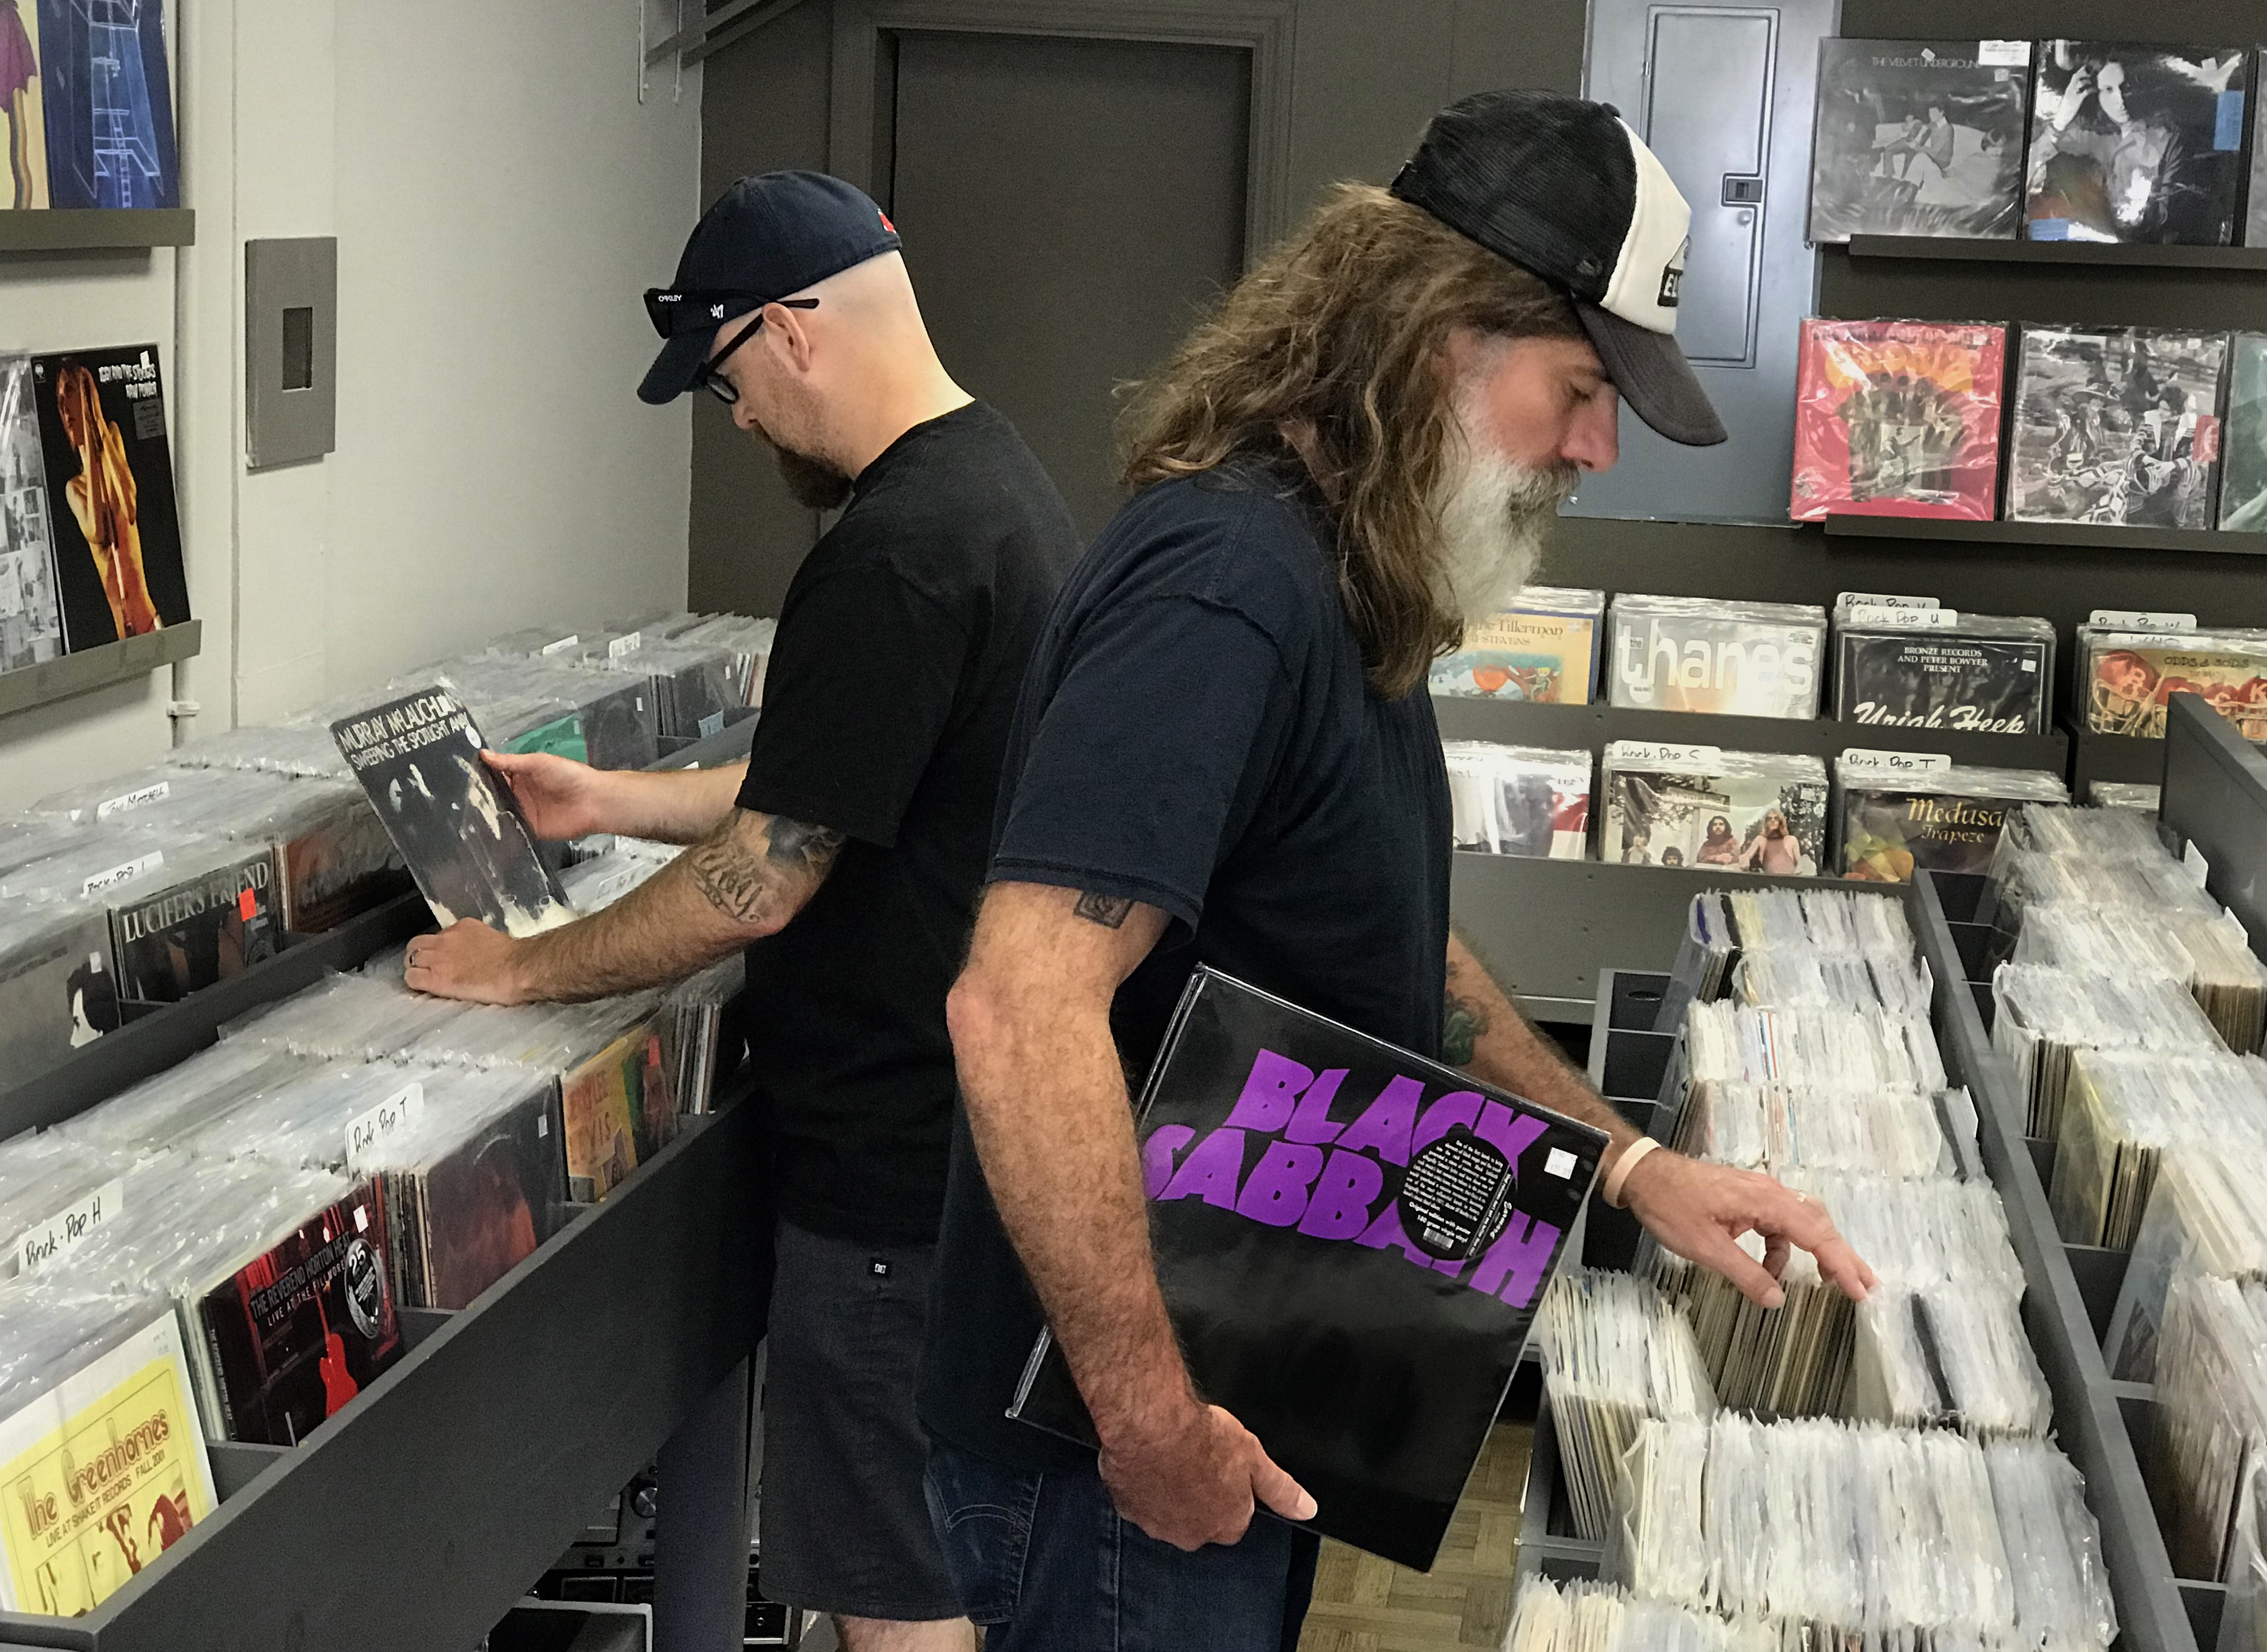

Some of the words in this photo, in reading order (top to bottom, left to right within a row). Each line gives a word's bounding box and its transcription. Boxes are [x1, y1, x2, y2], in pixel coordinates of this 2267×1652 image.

[1872, 56, 1887, 67] THE
[1889, 57, 1919, 67] VELVET
[1920, 58, 1980, 69] UNDERGROUN
[658, 294, 682, 302] OAKLEY
[1499, 619, 1564, 640] Tillerman
[1858, 609, 1889, 623] Rock
[1896, 611, 1919, 624] Pop
[1930, 613, 1939, 624] U
[1618, 618, 1814, 696] thanes
[1897, 655, 1918, 663] AND
[1920, 656, 1948, 664] PETER
[1949, 657, 1988, 666] BOWYER
[1904, 646, 1939, 656] BRONZE
[1941, 648, 1982, 657] RECORDS
[2164, 656, 2198, 667] ODDS
[2213, 659, 2250, 668] SODS
[1923, 664, 1962, 673] PRESENT
[336, 715, 389, 753] MURRAY
[1949, 705, 2025, 734] Heep
[351, 742, 395, 771] SWEEPING
[391, 735, 411, 755] THE
[407, 720, 450, 749] SPOTLIGHT
[449, 711, 471, 734] AWAY
[1919, 759, 1937, 769] T
[1906, 797, 2003, 827] Medusa
[1921, 824, 1985, 845] Trapeze
[209, 862, 269, 908] FRIEND
[399, 1096, 407, 1117] T
[1223, 1048, 1550, 1191] BLACK
[65, 1213, 87, 1244] Pop
[92, 1195, 101, 1225] H
[1140, 1124, 1562, 1309] SABBH
[1409, 1201, 1429, 1214] Original
[1455, 1225, 1471, 1236] poster
[250, 1293, 269, 1319] THE
[267, 1265, 307, 1308] REVEREND
[304, 1245, 336, 1280] HORTON
[333, 1230, 352, 1257] HEAT
[348, 1243, 367, 1277] 25
[267, 1306, 285, 1327] LIVE
[286, 1298, 295, 1312] AT
[296, 1285, 312, 1304] THE
[312, 1260, 347, 1293] FILLMORE
[16, 1475, 59, 1541] The
[61, 1409, 170, 1508] Greenhornes
[45, 1527, 62, 1548] LIVE
[62, 1519, 72, 1536] AT
[101, 1474, 132, 1505] RECORDS
[135, 1460, 153, 1479] FALL
[152, 1448, 166, 1467] 2001
